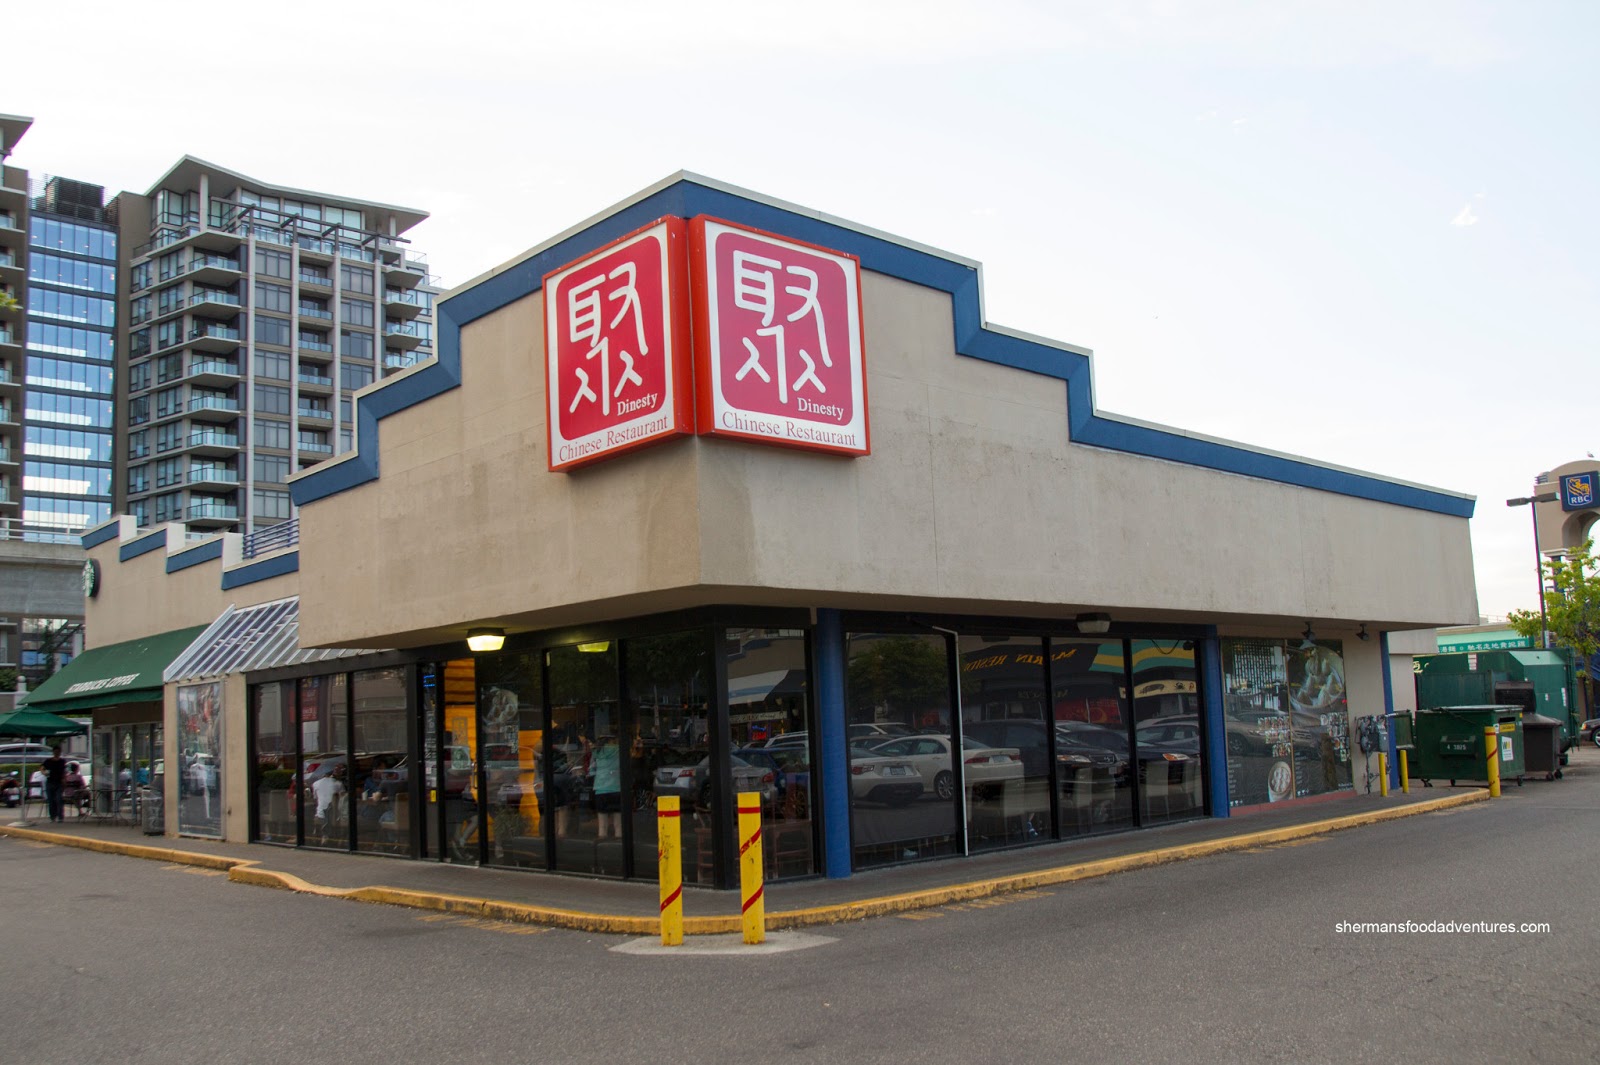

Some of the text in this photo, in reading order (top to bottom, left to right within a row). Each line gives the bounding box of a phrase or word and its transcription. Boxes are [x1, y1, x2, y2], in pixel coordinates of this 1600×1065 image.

[617, 393, 658, 416] Dinesty
[797, 398, 844, 420] Dinesty
[559, 415, 668, 462] Chinese Restaurant
[722, 411, 856, 447] Chinese Restaurant
[1571, 496, 1589, 504] RBC
[64, 673, 141, 694] STARBUCKS COFFEE
